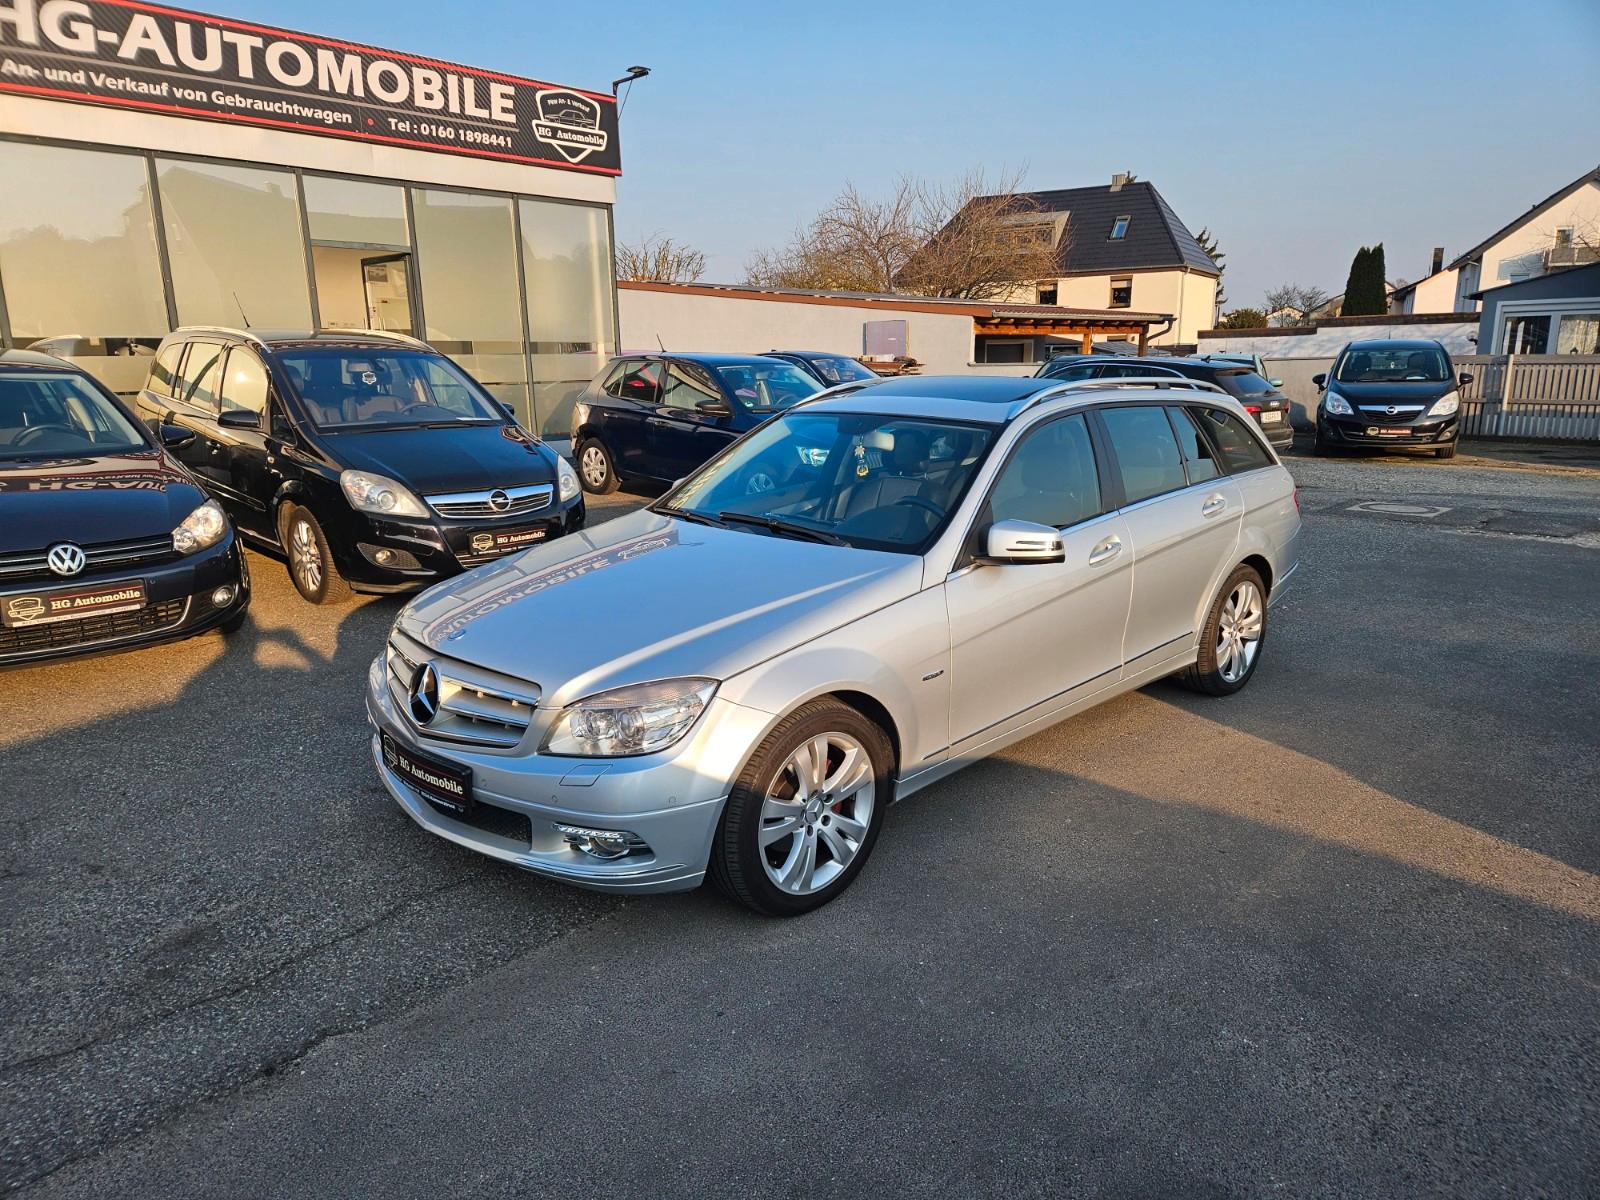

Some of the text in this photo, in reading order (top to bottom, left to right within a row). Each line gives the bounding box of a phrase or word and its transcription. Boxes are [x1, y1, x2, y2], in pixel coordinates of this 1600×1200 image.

[0, 0, 517, 123] HG-AUTOMOBILE
[0, 58, 353, 124] An- und Verkauf von Gebrauchtwagen
[420, 123, 455, 140] 0160
[458, 129, 513, 149] 1898441
[537, 126, 605, 146] HG Automobile
[51, 599, 72, 611] HG
[74, 590, 141, 606] Automobile
[399, 756, 410, 771] HG
[411, 764, 463, 794] Automobile
